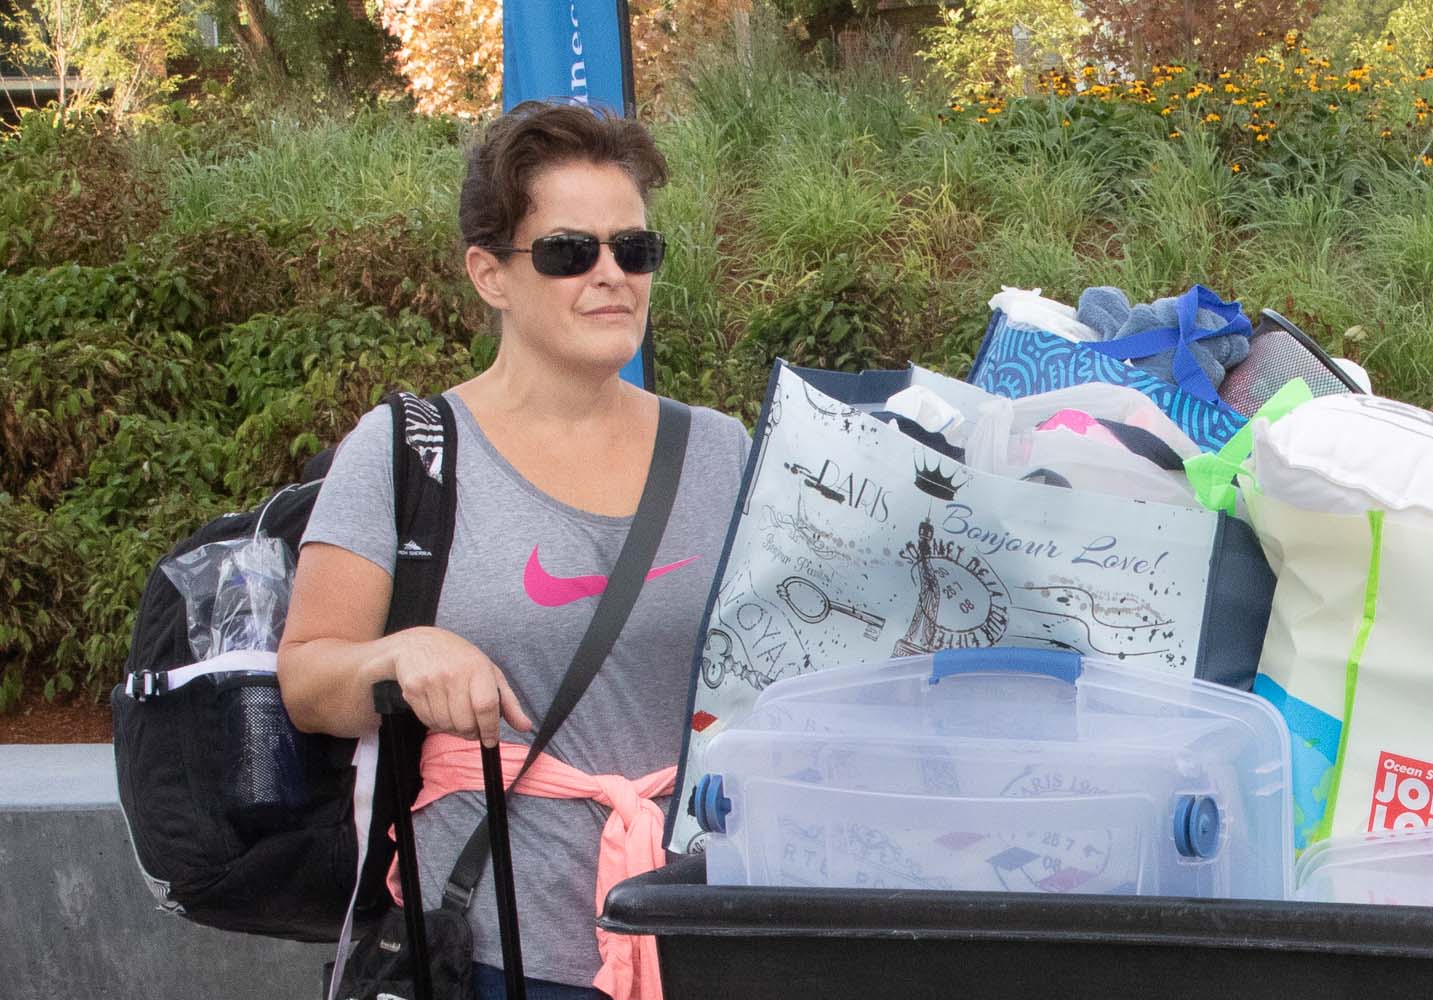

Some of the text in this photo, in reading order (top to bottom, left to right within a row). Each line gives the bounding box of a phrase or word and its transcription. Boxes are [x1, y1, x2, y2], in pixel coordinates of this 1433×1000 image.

[817, 459, 893, 523] PARIS
[942, 502, 1169, 576] Bonjour Love!
[959, 598, 975, 614] 08
[1383, 758, 1423, 778] Ocean
